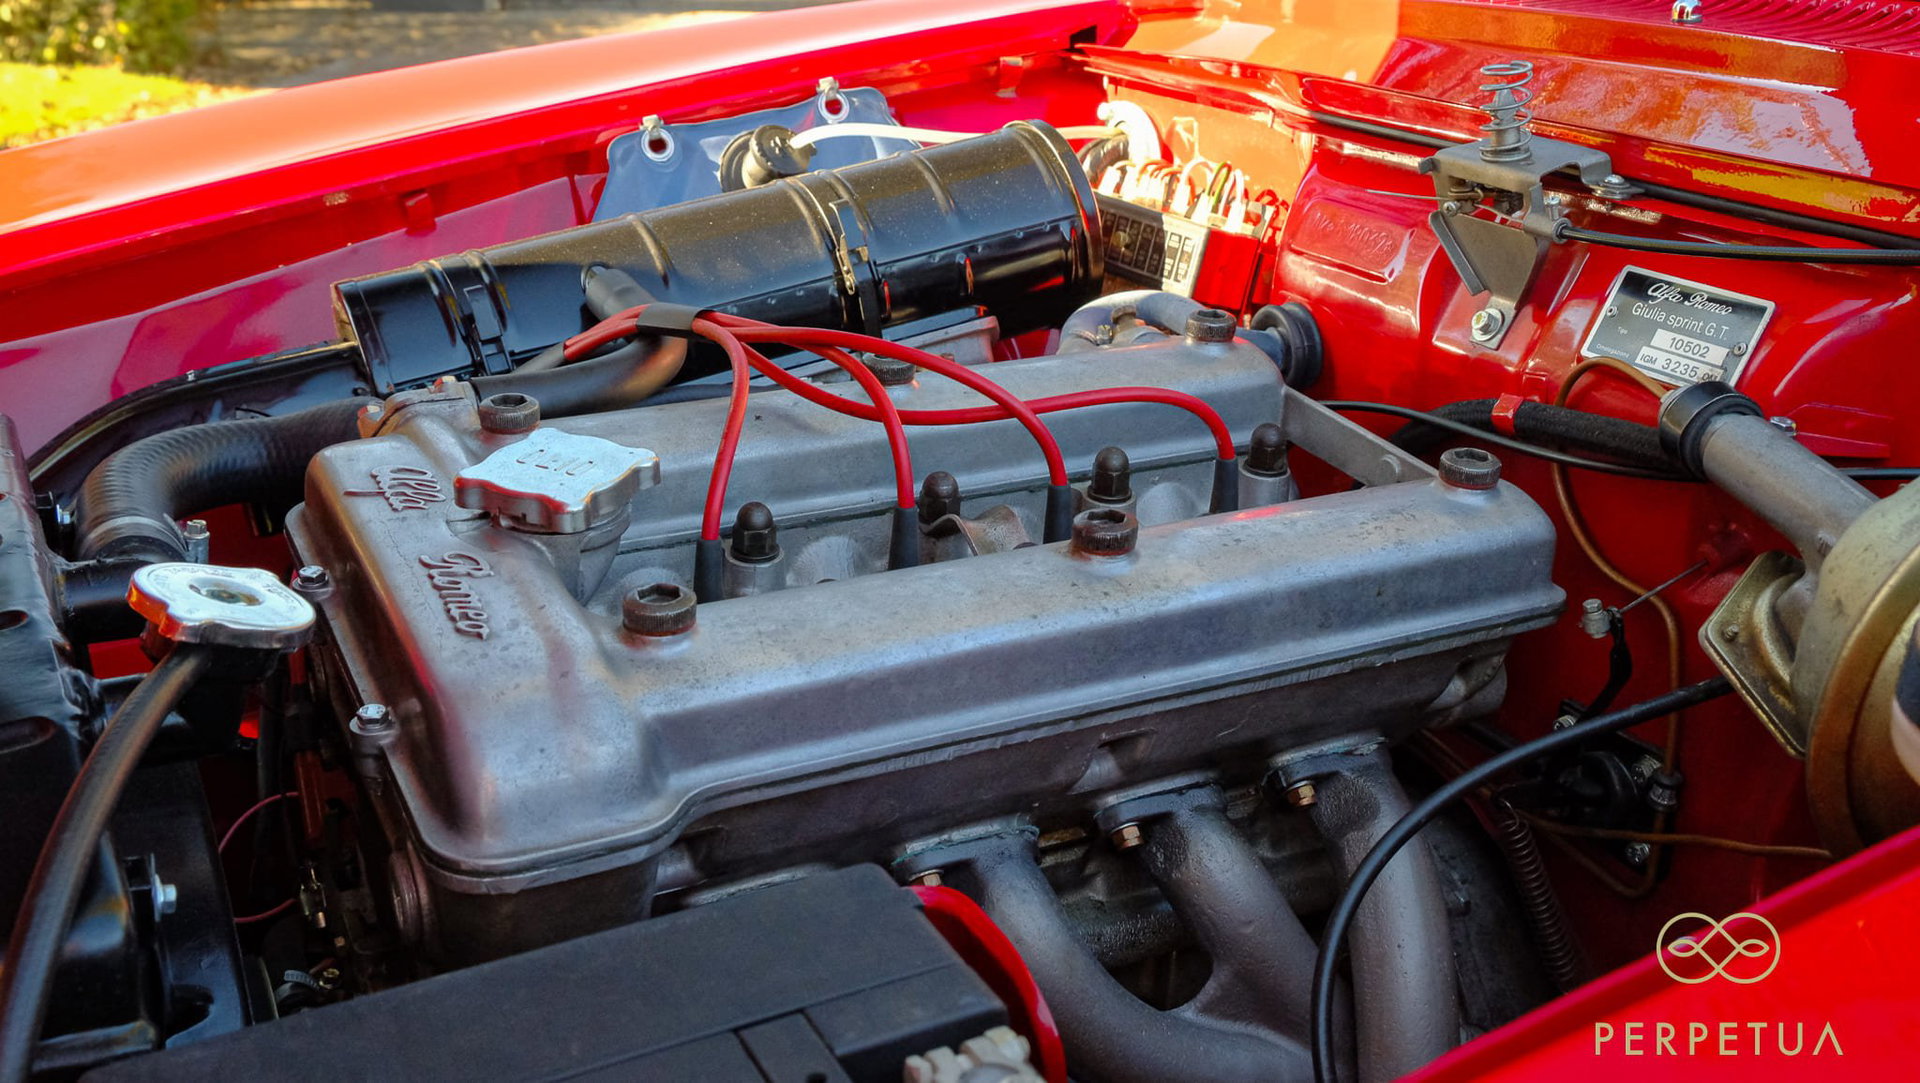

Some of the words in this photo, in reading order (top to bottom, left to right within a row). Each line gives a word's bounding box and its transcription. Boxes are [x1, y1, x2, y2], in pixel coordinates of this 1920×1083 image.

[1647, 282, 1684, 305] Alfa
[1684, 292, 1733, 316] Romeo
[1632, 302, 1665, 323] Giulia
[1666, 312, 1703, 334] sprint
[1704, 322, 1728, 341] G.T.
[1669, 336, 1711, 359] 10502
[1639, 353, 1658, 366] IGM
[1661, 357, 1700, 378] 3235
[343, 465, 447, 512] Alfa
[418, 552, 496, 641] Romeo
